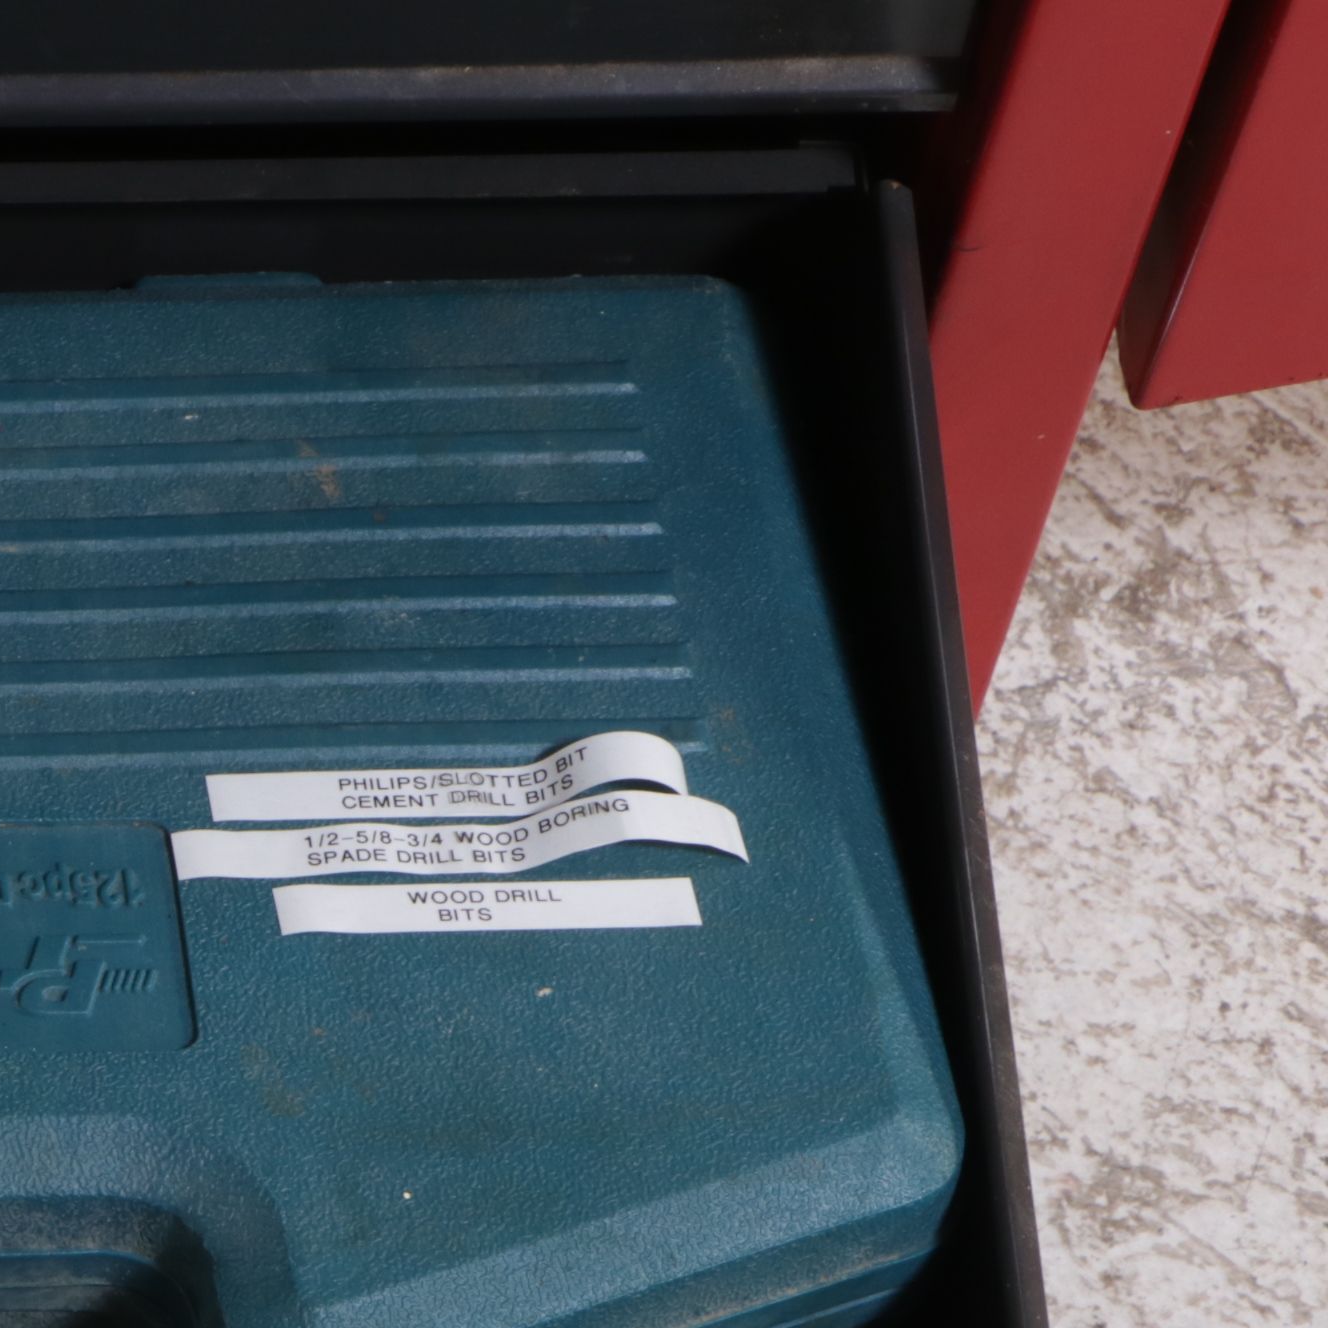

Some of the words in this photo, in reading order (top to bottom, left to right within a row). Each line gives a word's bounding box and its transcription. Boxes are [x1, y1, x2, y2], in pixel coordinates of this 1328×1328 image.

[338, 769, 548, 793] PHILIPS/SLOTTED
[554, 745, 590, 773] BIT
[341, 794, 439, 810] CEMENT
[447, 789, 516, 808] DRILL
[525, 775, 575, 805] BITS
[304, 830, 444, 849] 1/2-5/8-3/4
[454, 826, 529, 846] WOOD
[537, 797, 632, 835] BORING
[306, 848, 387, 867] SPADE
[396, 849, 463, 865] DRILL
[472, 847, 527, 863] BITS
[407, 890, 485, 905] WOOD
[494, 888, 562, 904] DRILL
[438, 907, 493, 922] BITS
